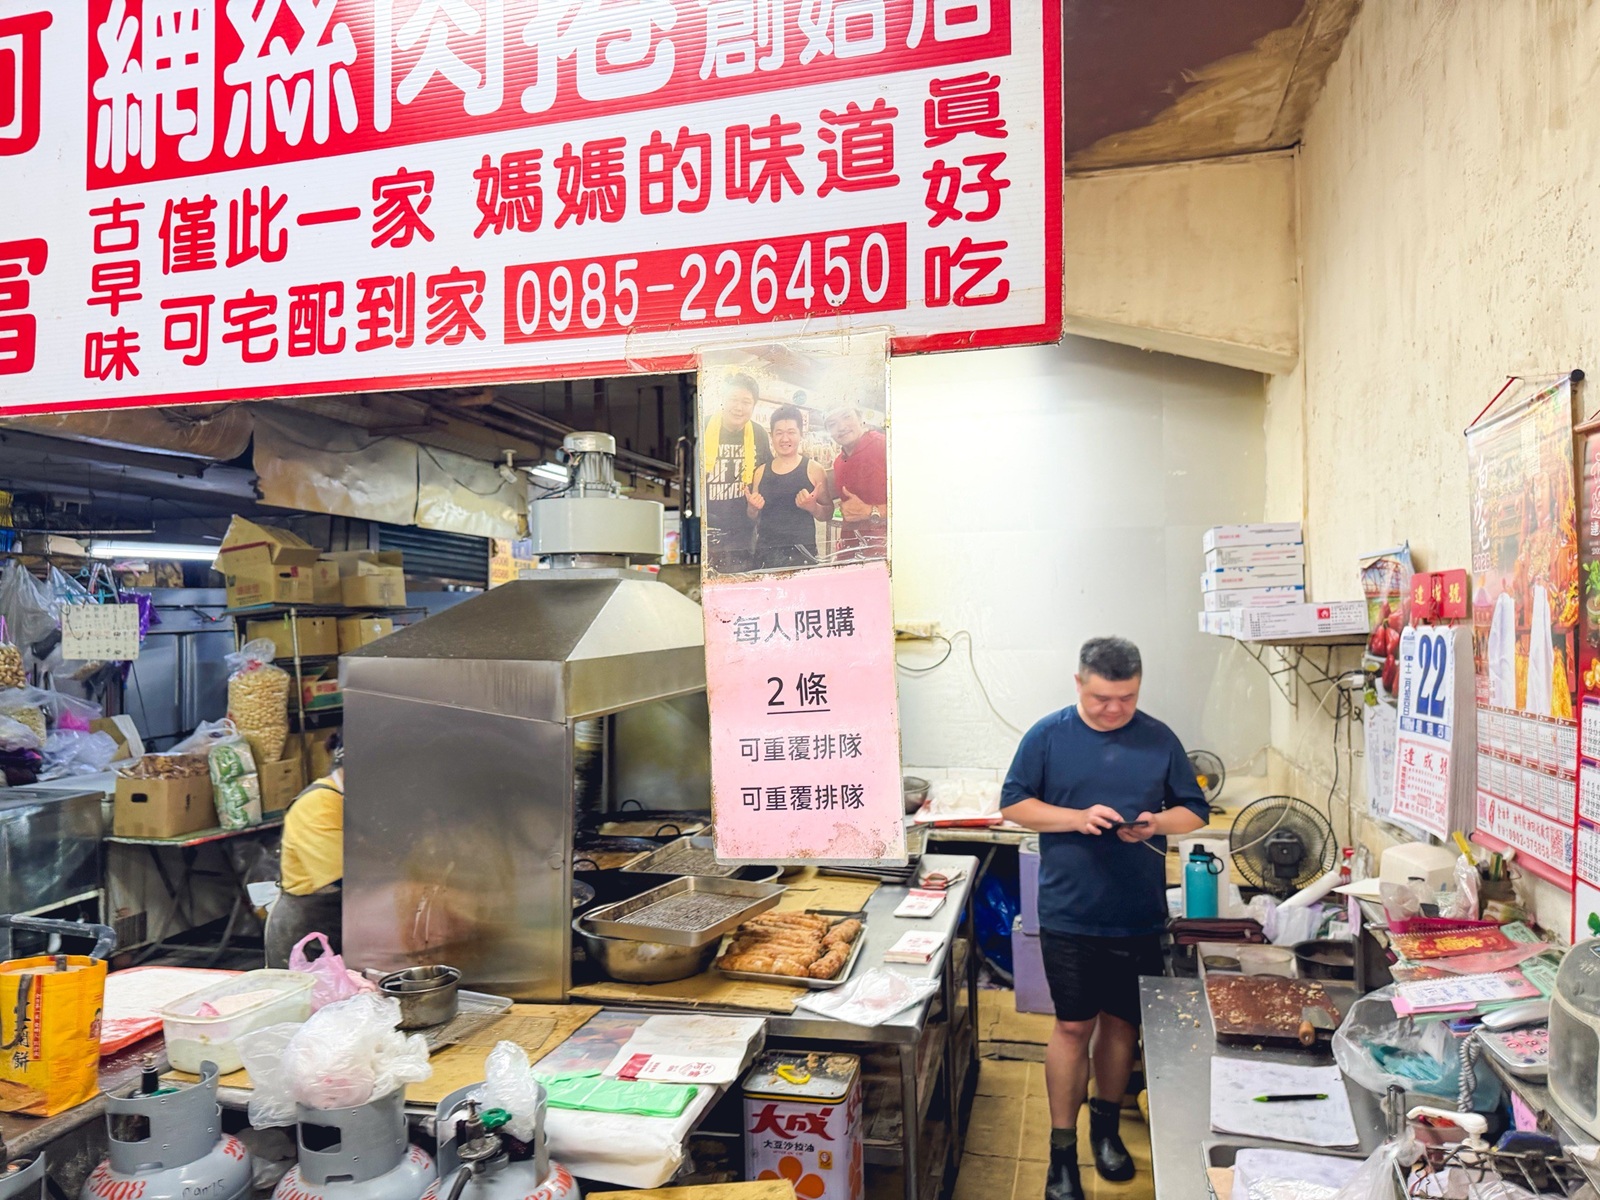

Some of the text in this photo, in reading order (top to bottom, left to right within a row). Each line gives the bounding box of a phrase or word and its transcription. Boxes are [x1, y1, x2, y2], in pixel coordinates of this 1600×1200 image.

[158, 98, 901, 275] 僅此一家 媽媽的味道
[84, 197, 146, 381] 古早味
[161, 266, 487, 366] 可宅配到家
[516, 232, 890, 335] 0985-226450
[733, 606, 855, 645] 每人限購
[767, 672, 828, 707] 2 條
[1415, 634, 1447, 719] 22
[739, 733, 863, 762] 可重覆排隊
[740, 783, 865, 811] 可重覆排隊
[747, 1104, 836, 1141] 大成
[763, 1139, 815, 1153] 大豆沙拉油
